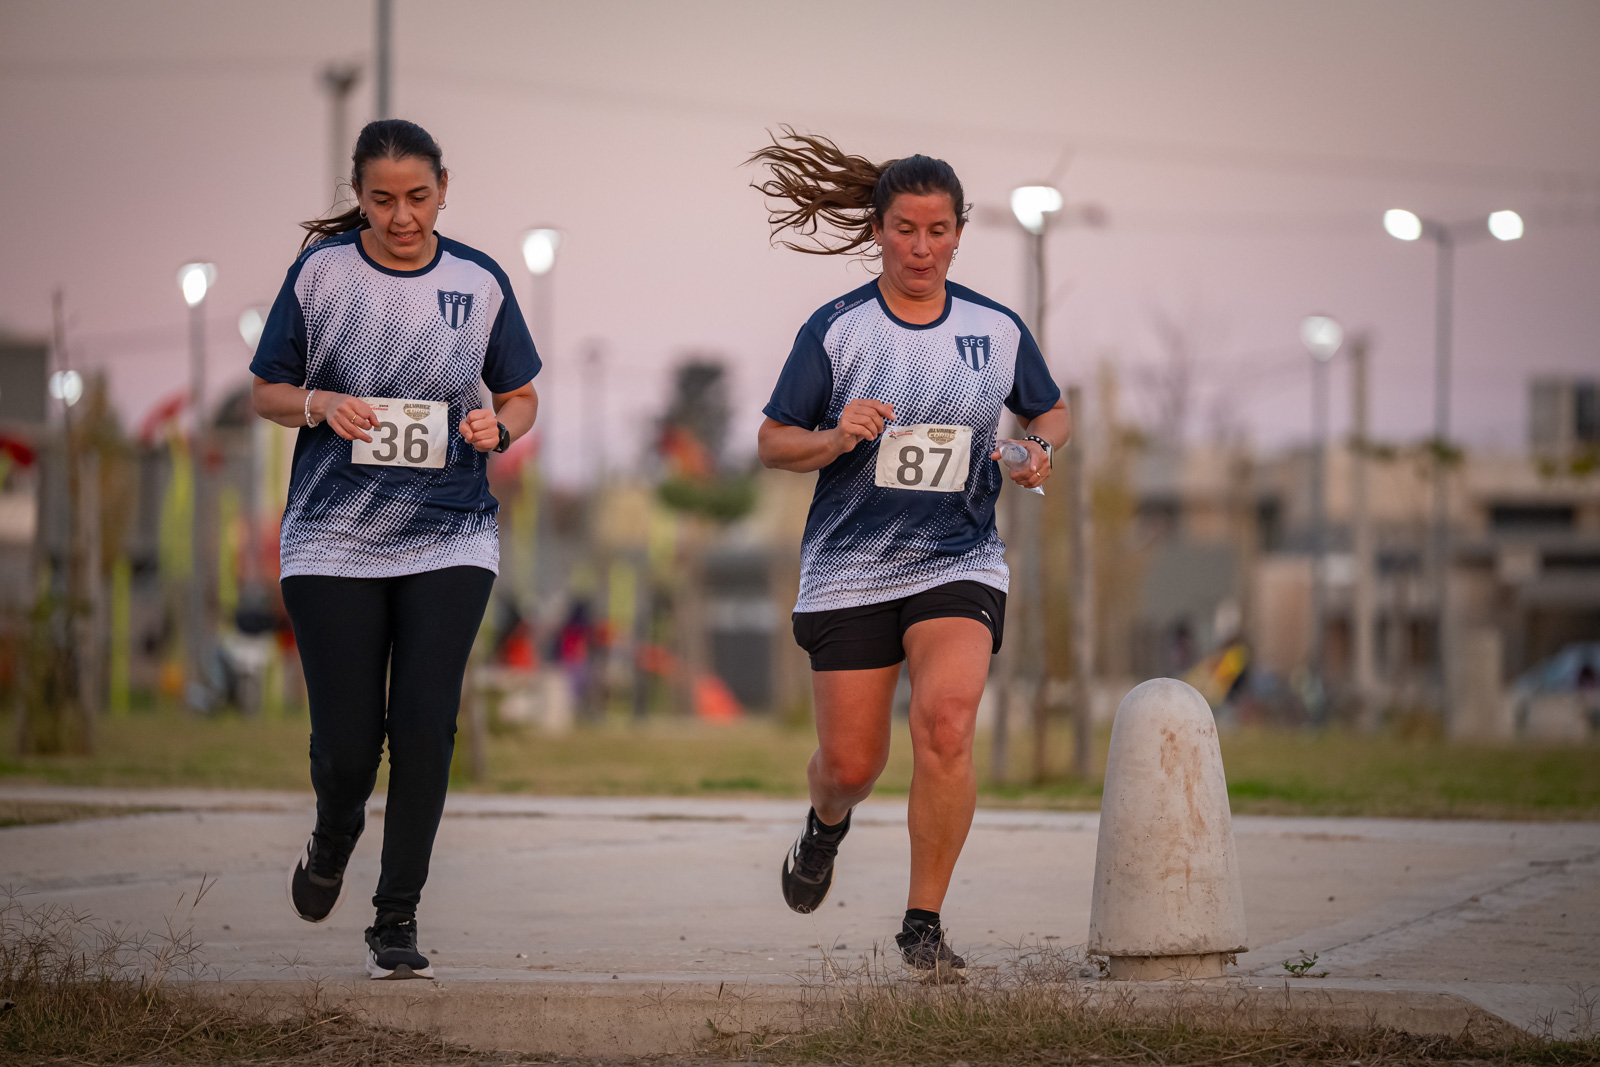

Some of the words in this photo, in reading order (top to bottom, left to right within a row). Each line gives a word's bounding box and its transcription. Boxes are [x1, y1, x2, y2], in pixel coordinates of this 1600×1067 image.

[444, 293, 467, 305] SFC
[962, 338, 984, 347] SFC
[372, 421, 429, 463] 36
[928, 432, 956, 440] CORRE
[896, 445, 953, 487] 87
